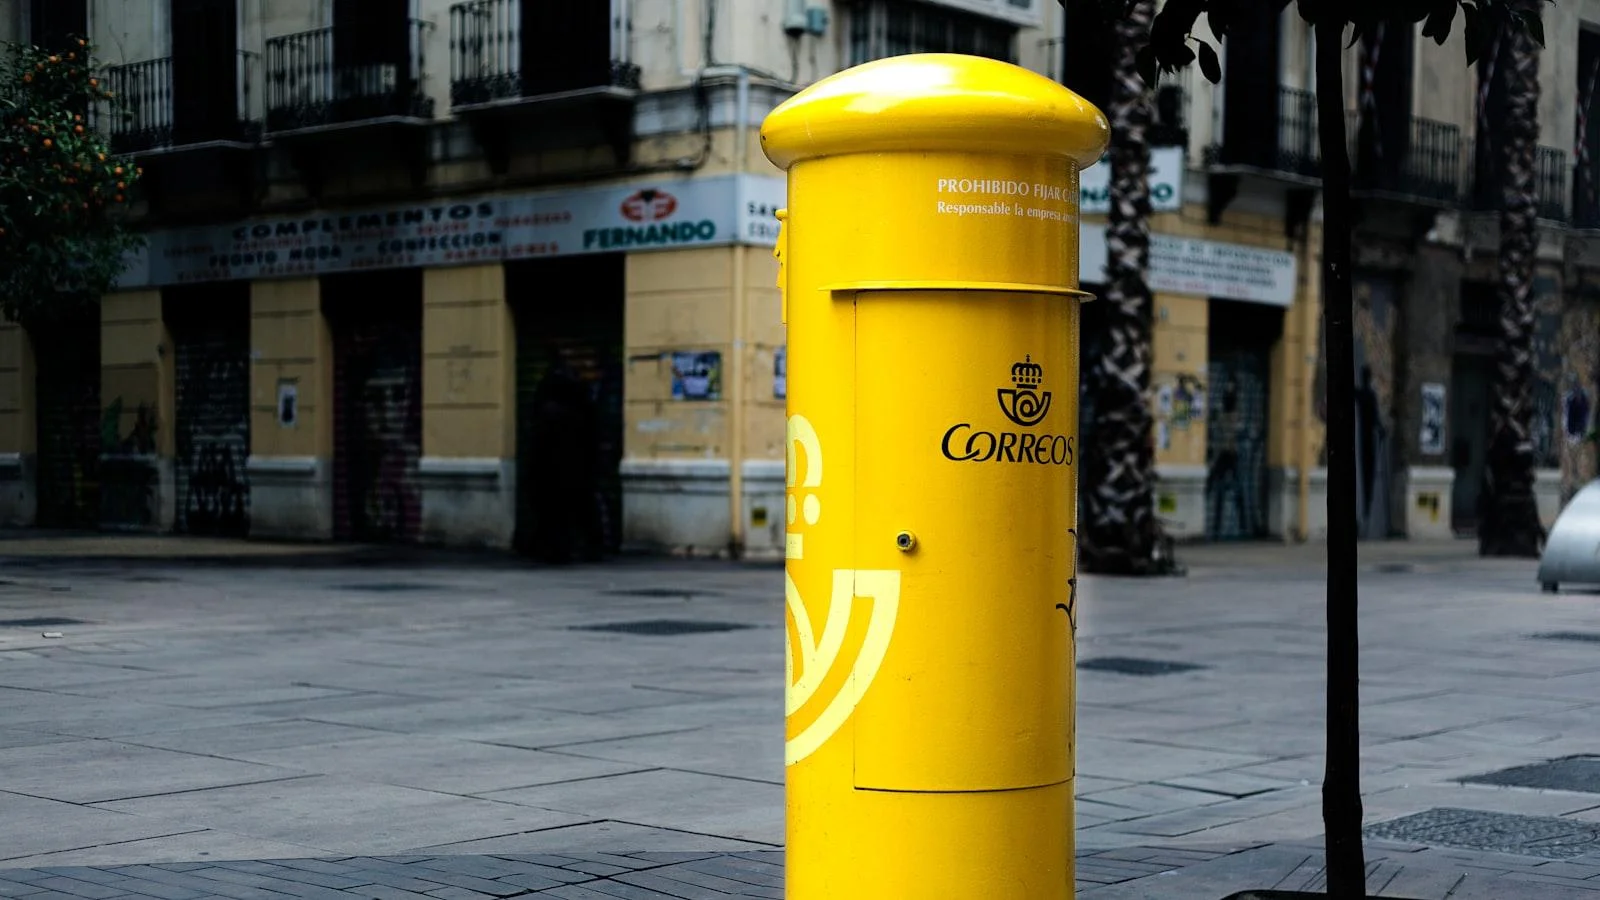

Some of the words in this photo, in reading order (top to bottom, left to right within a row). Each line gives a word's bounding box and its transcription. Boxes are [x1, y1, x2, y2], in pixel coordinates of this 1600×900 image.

[938, 178, 1030, 196] PROHIBIDO
[1034, 184, 1060, 201] FIJAR
[233, 202, 493, 240] COMPLEMENTOS
[937, 200, 1011, 216] Responsable
[1015, 203, 1024, 216] la
[1027, 206, 1061, 221] empresa
[584, 220, 716, 249] FERNANDO
[209, 250, 278, 267] PRONTO
[290, 245, 342, 260] MODA
[941, 423, 1074, 466] CORREOS
